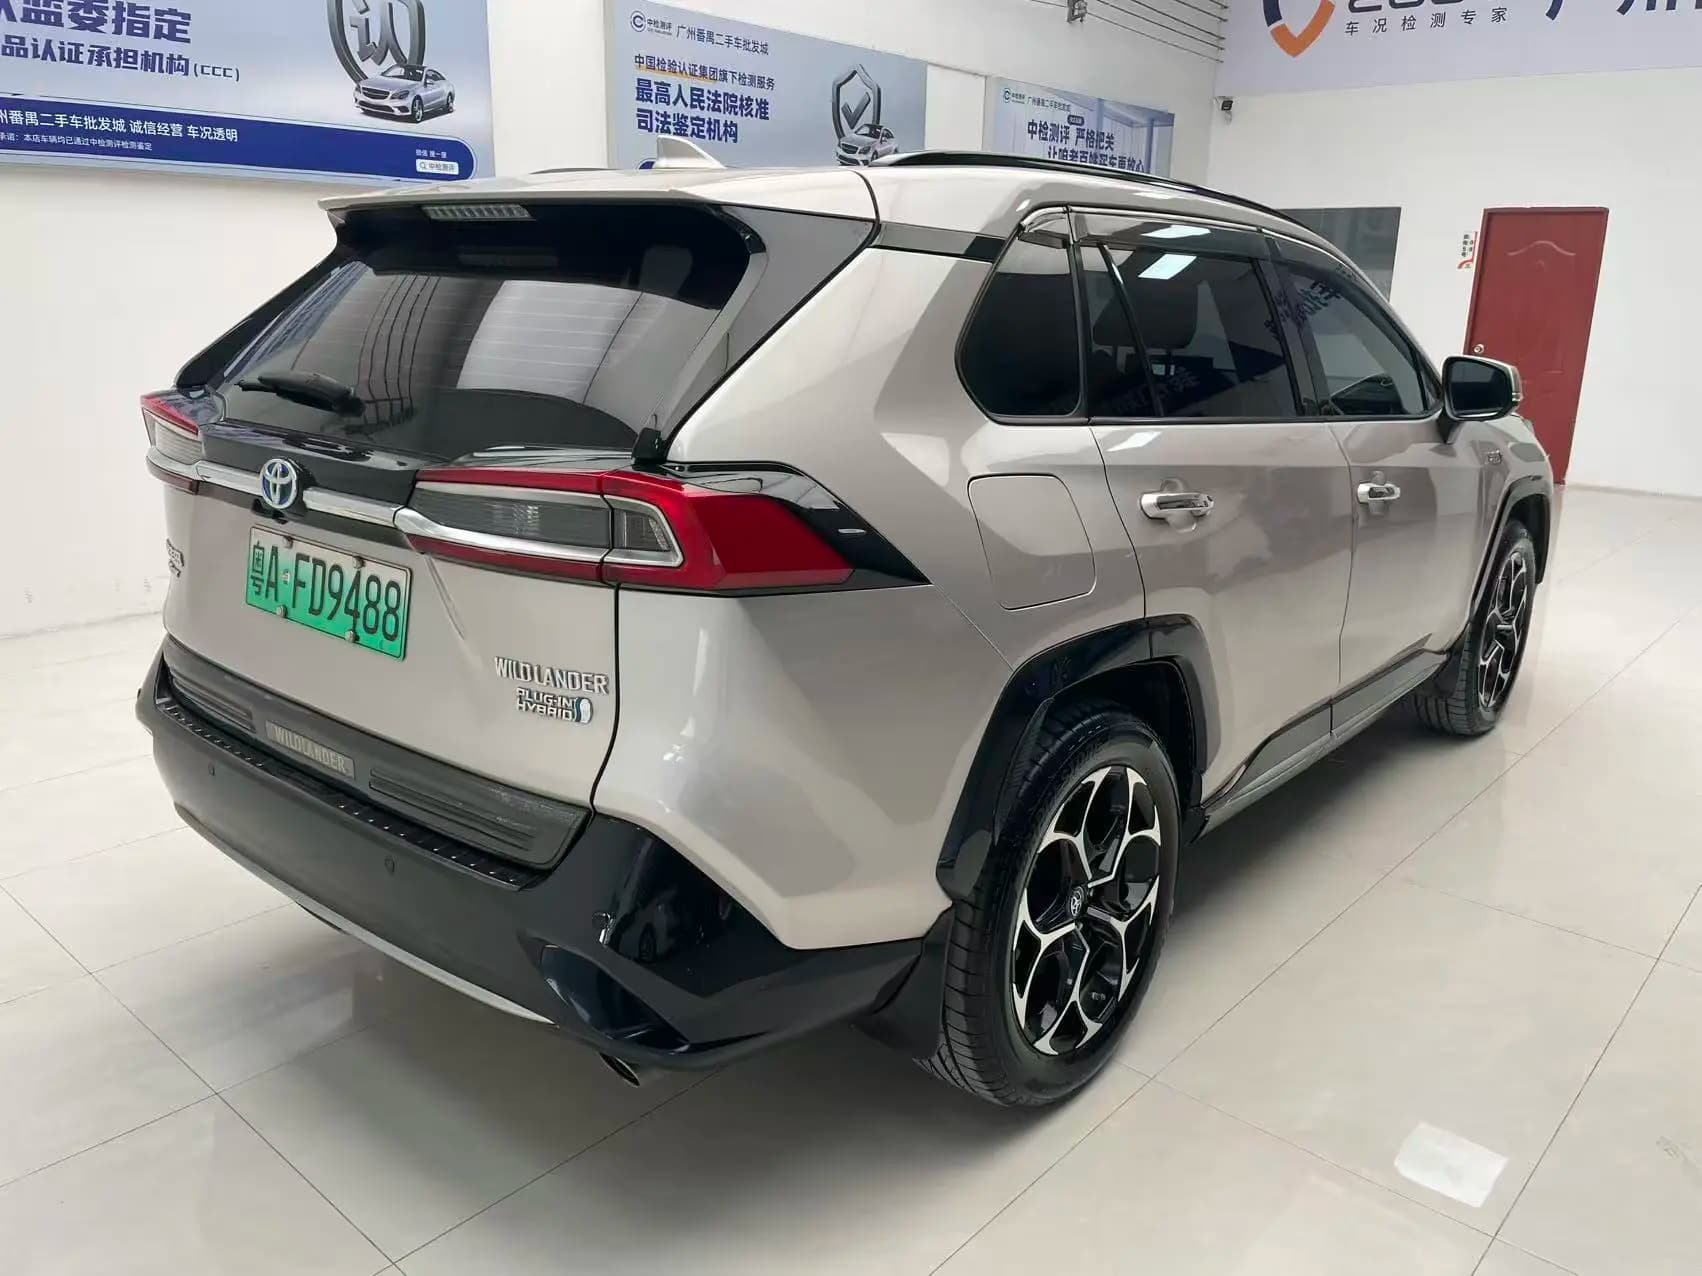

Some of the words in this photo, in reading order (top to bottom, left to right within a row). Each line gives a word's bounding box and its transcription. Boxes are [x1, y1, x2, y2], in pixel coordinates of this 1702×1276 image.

[1345, 7, 1508, 36] 车况检测专家
[676, 25, 769, 56] 广州番禺二手车批发城
[634, 53, 775, 91] 中国检验认证集团旗下检测服务
[635, 77, 770, 120] 最高人民法院核准
[130, 119, 184, 138] 诚信经营
[187, 125, 238, 142] 车况透明
[636, 107, 738, 143] 司法鉴定机构
[1027, 119, 1070, 145] 中检测评
[1075, 127, 1115, 151] 严格把关
[515, 687, 576, 709] PLUG-IN
[516, 699, 576, 722] HYBRID
